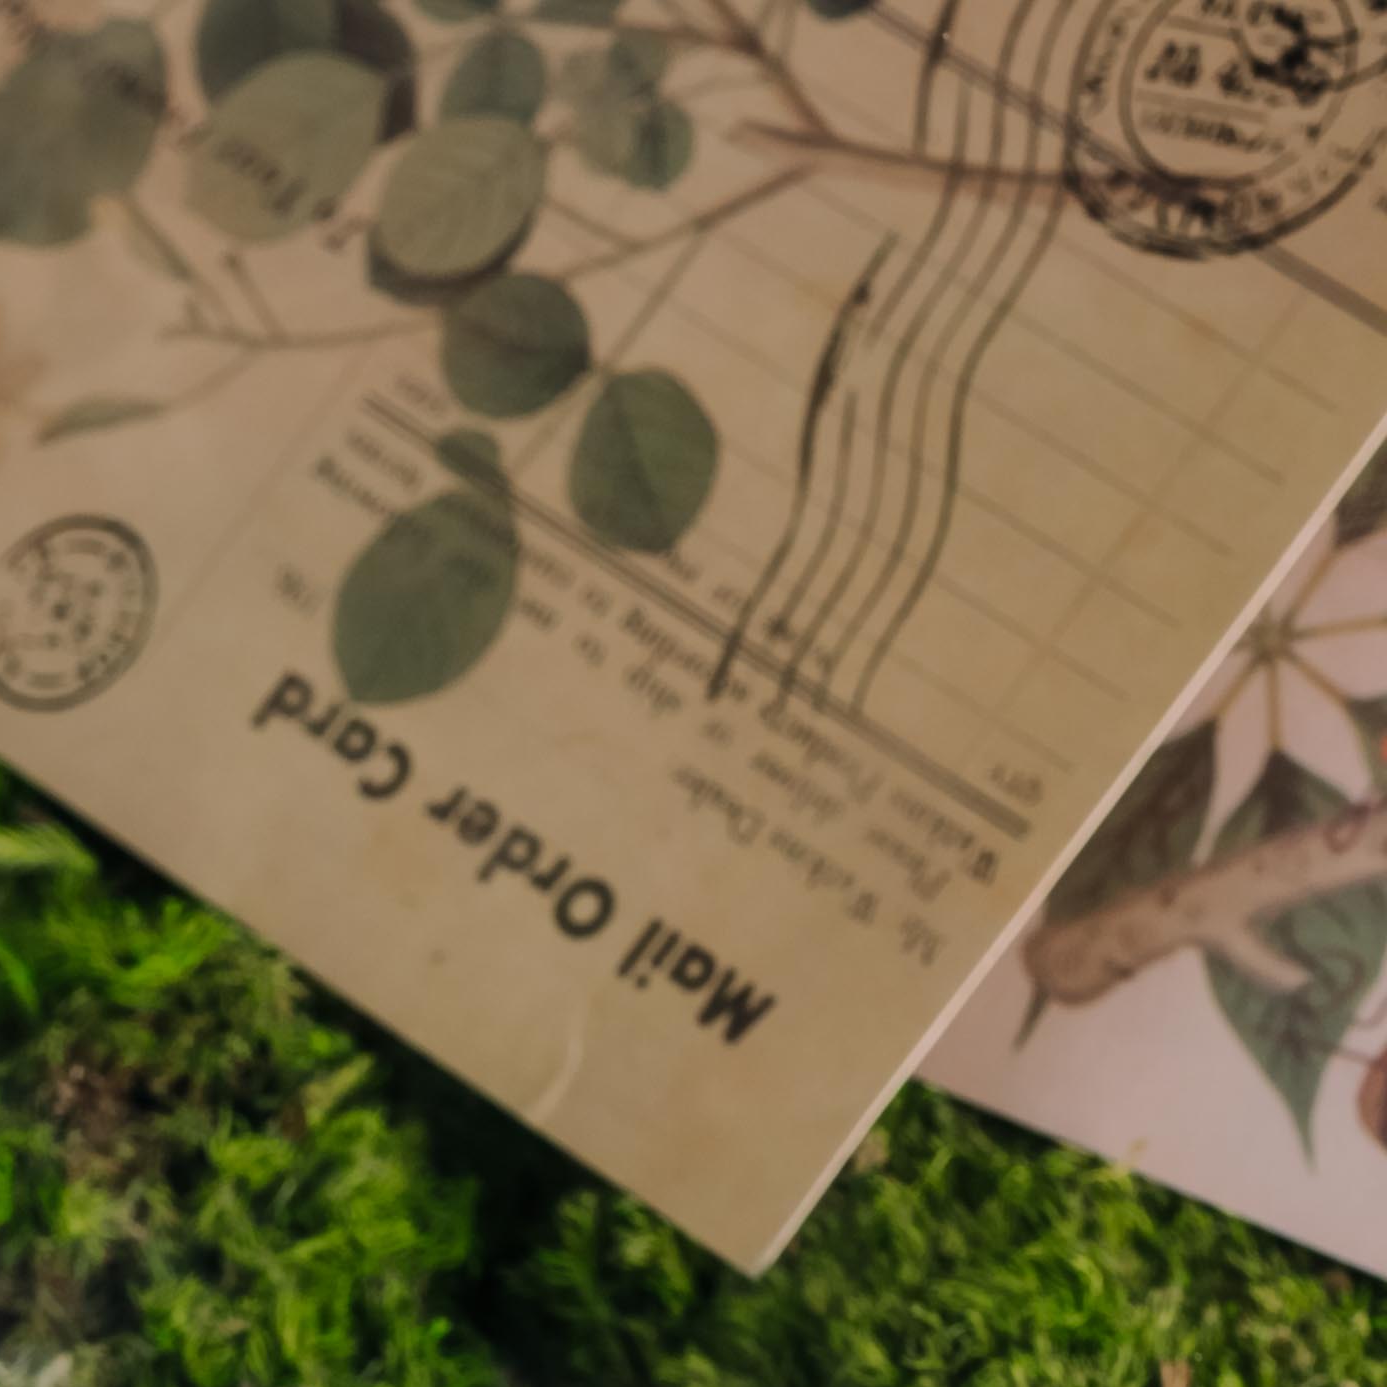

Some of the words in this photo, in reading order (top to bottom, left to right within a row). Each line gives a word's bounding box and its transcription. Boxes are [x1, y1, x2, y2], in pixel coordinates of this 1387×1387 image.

[571, 632, 606, 668] to
[252, 672, 412, 800] Card
[427, 789, 615, 939] Order
[618, 920, 773, 1043] Mail
